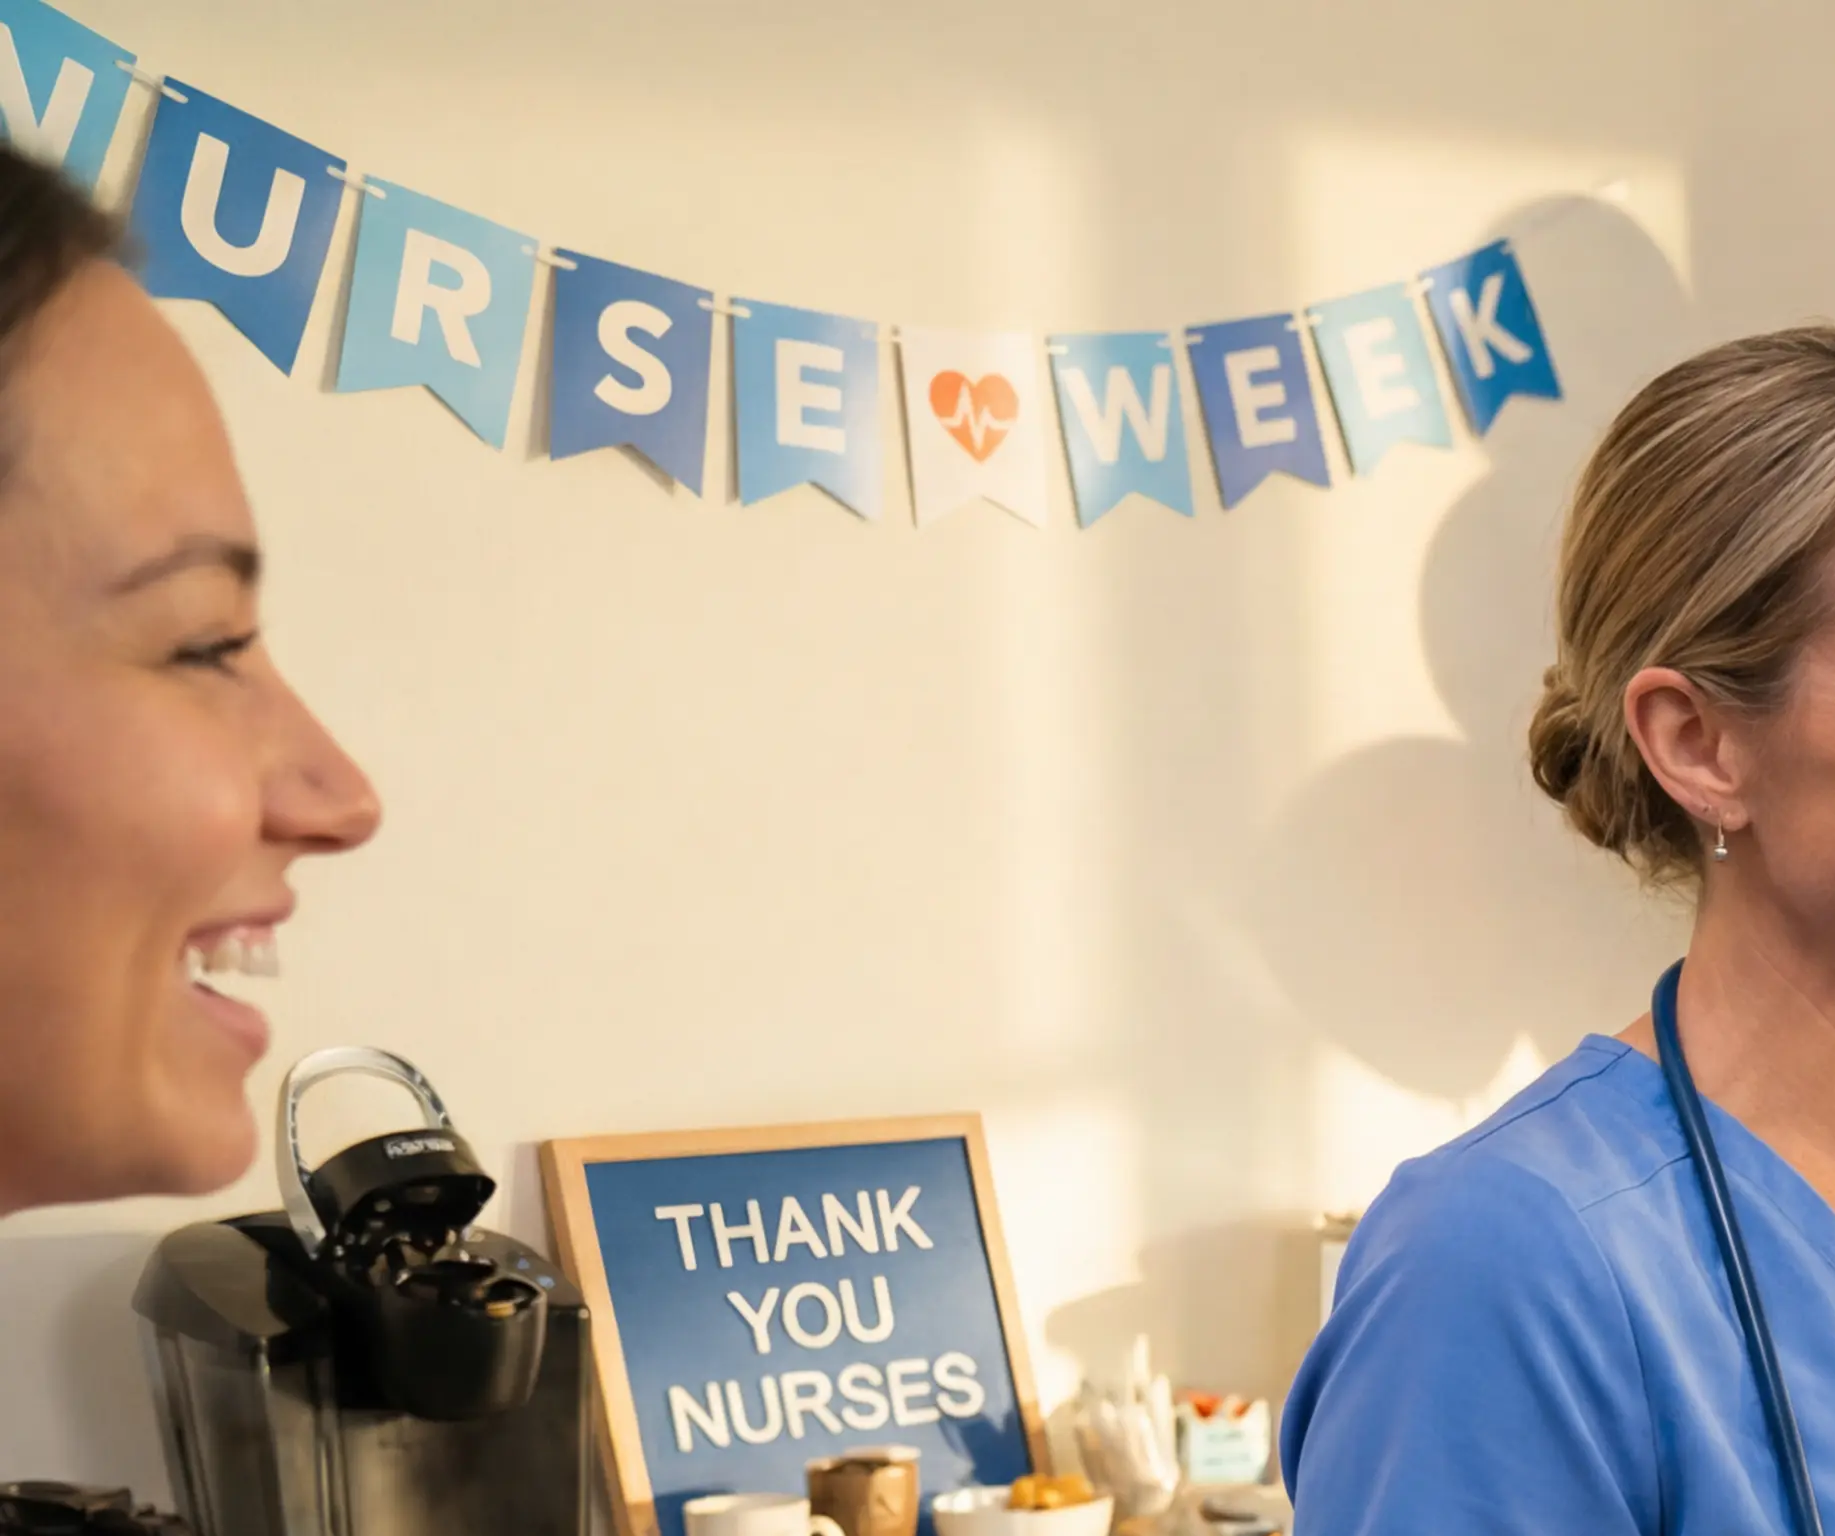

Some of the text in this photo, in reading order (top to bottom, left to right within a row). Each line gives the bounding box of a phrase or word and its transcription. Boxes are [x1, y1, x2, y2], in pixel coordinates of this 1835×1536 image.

[0, 20, 1534, 466] NURSE WEEK
[653, 1185, 935, 1272] THANK
[725, 1275, 896, 1356] YOU
[666, 1351, 986, 1453] NURSES
